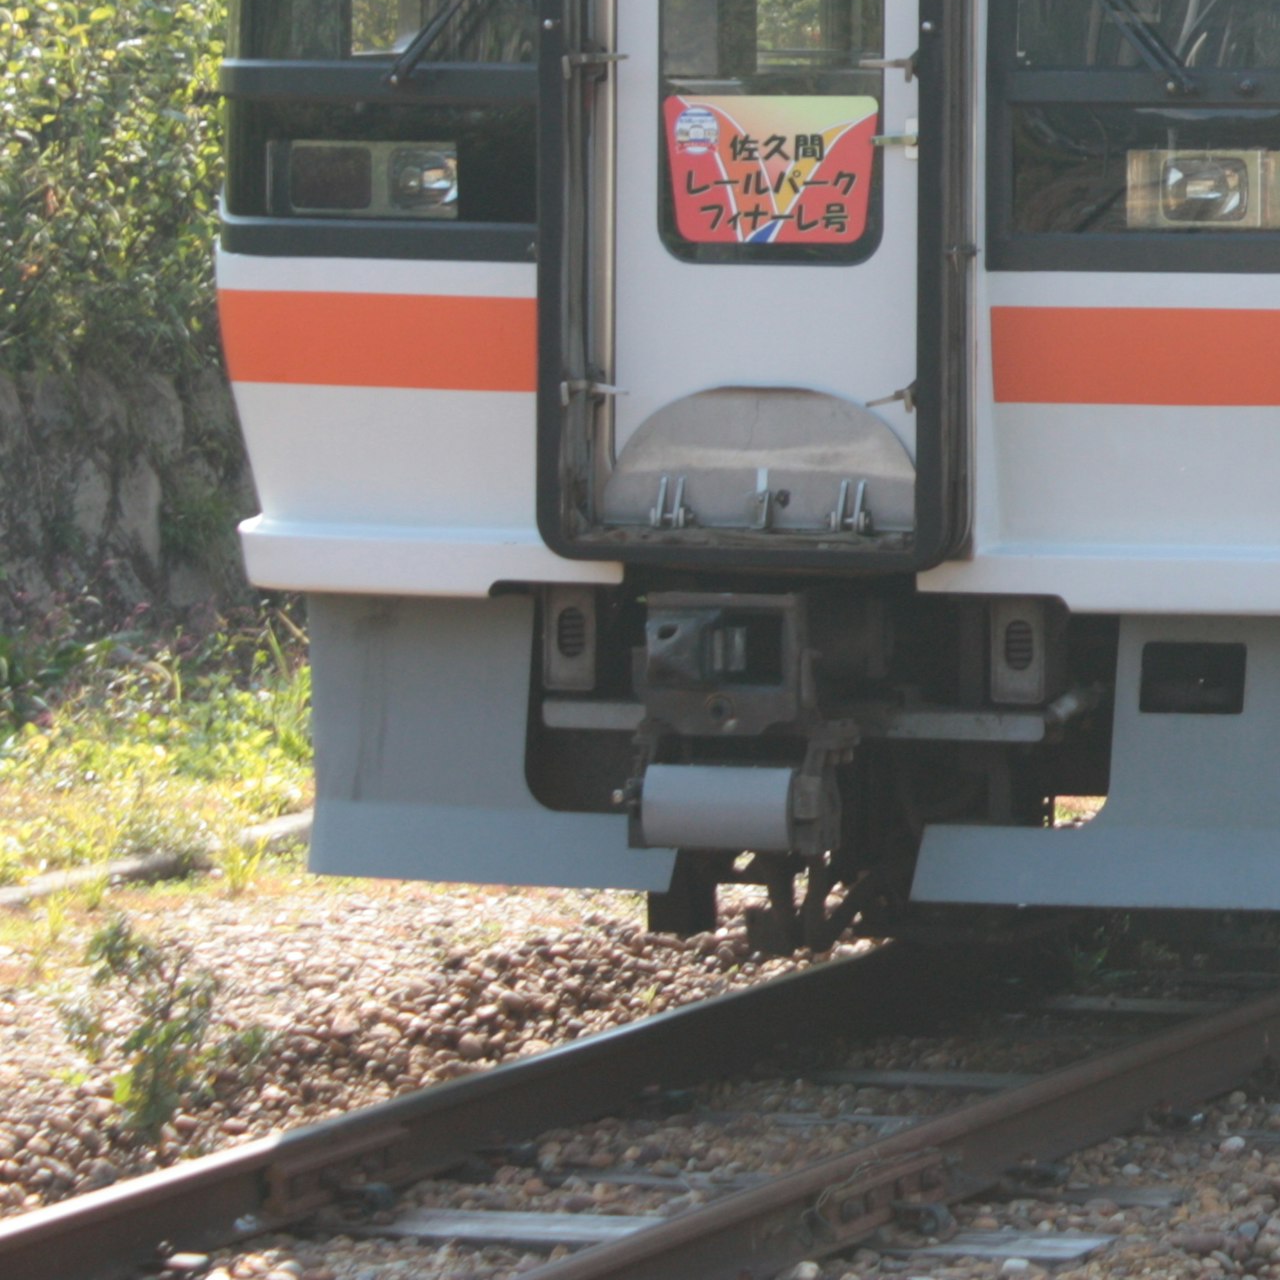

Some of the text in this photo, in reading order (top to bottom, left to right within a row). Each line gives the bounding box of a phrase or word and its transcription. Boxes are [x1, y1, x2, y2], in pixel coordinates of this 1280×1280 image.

[730, 133, 825, 162] 佐久間
[686, 170, 857, 195] レールパーク
[701, 203, 848, 233] フィナーレ号
